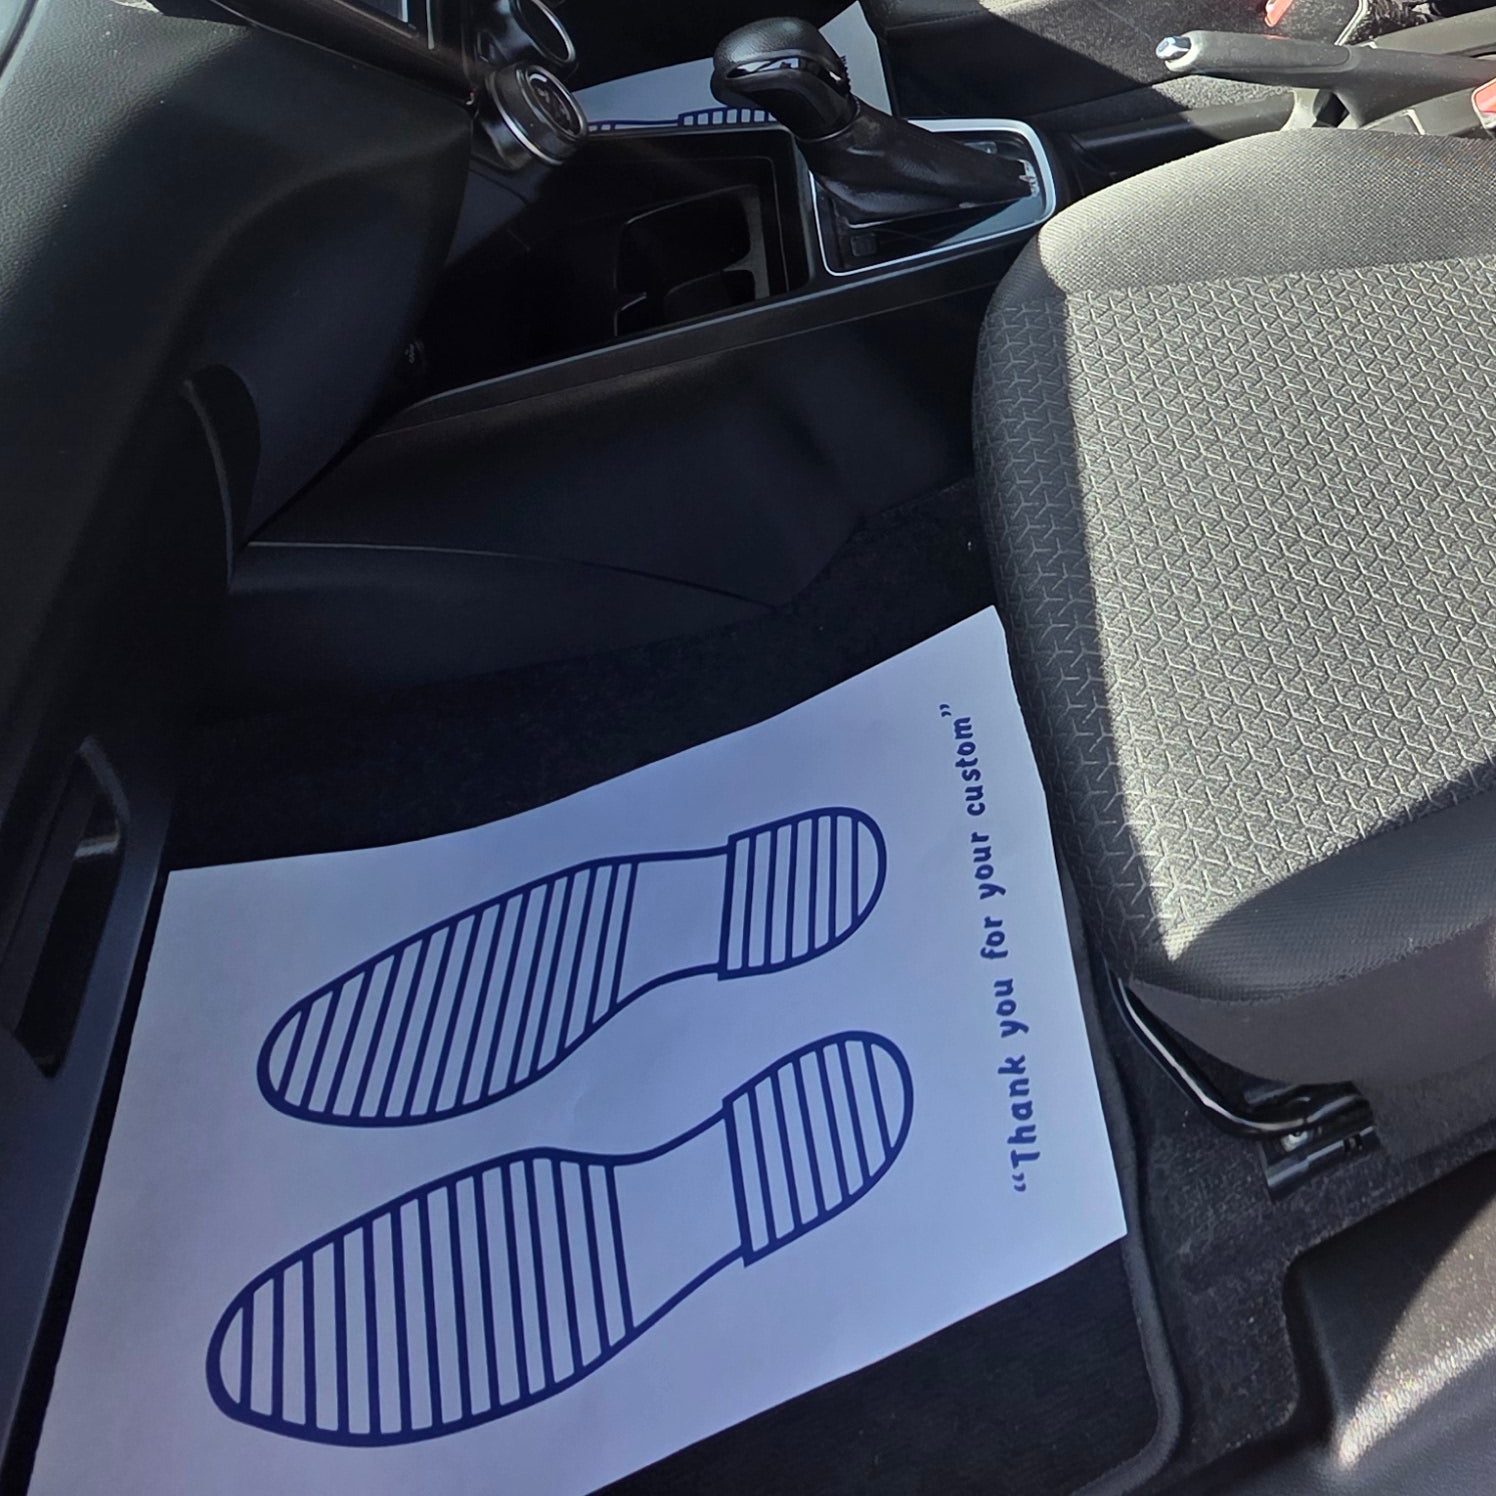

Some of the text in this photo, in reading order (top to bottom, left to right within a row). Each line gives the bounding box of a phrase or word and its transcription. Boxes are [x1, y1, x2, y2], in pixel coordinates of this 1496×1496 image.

[970, 831, 1007, 900] your
[979, 915, 1009, 961] for
[993, 977, 1030, 1039] you
